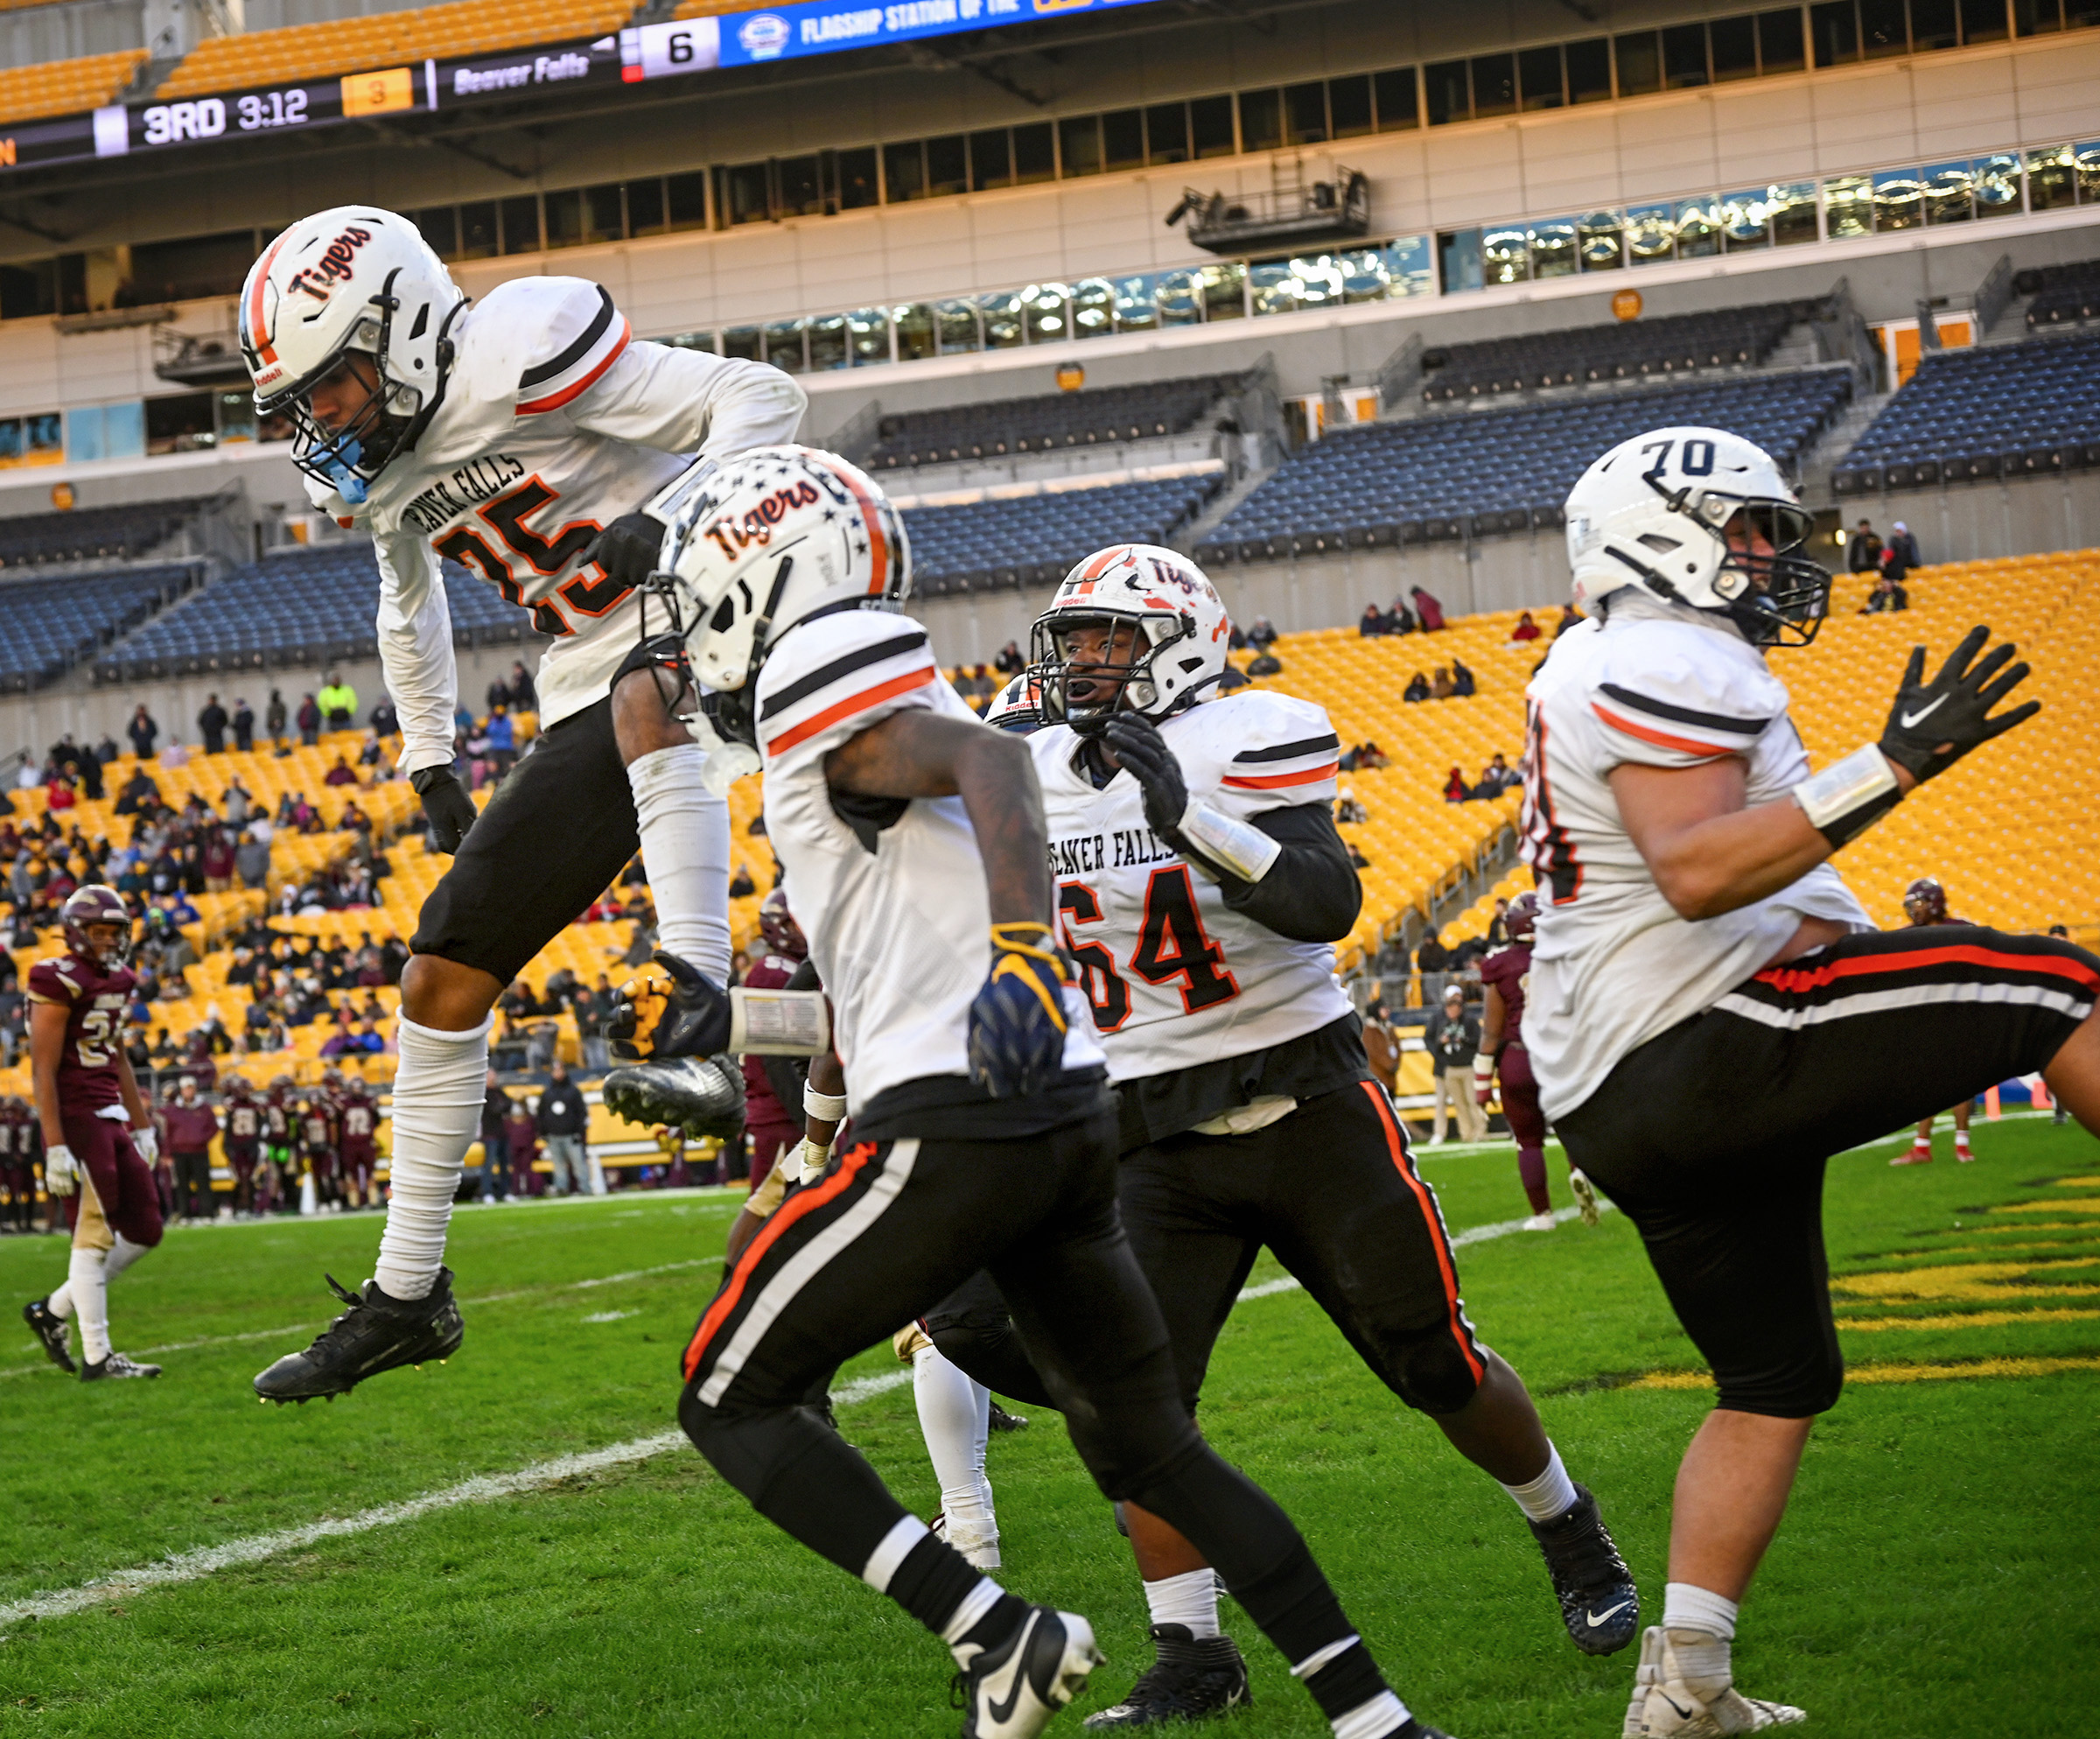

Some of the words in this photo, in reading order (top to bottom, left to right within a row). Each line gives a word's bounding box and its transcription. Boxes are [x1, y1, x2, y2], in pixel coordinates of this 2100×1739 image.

[800, 8, 883, 45] FLAGSHIP
[885, 1, 957, 32] STATION
[669, 32, 693, 63] 6
[368, 80, 387, 105] 3
[454, 68, 532, 95] Beaver
[535, 53, 589, 83] Falls
[143, 98, 226, 144] 3RD
[237, 89, 308, 130] 3:12
[288, 227, 371, 301] Tigers
[452, 453, 525, 501] FALLS
[1640, 438, 1716, 477] 70
[704, 480, 819, 562] Tigers
[1060, 864, 1241, 1032] 64
